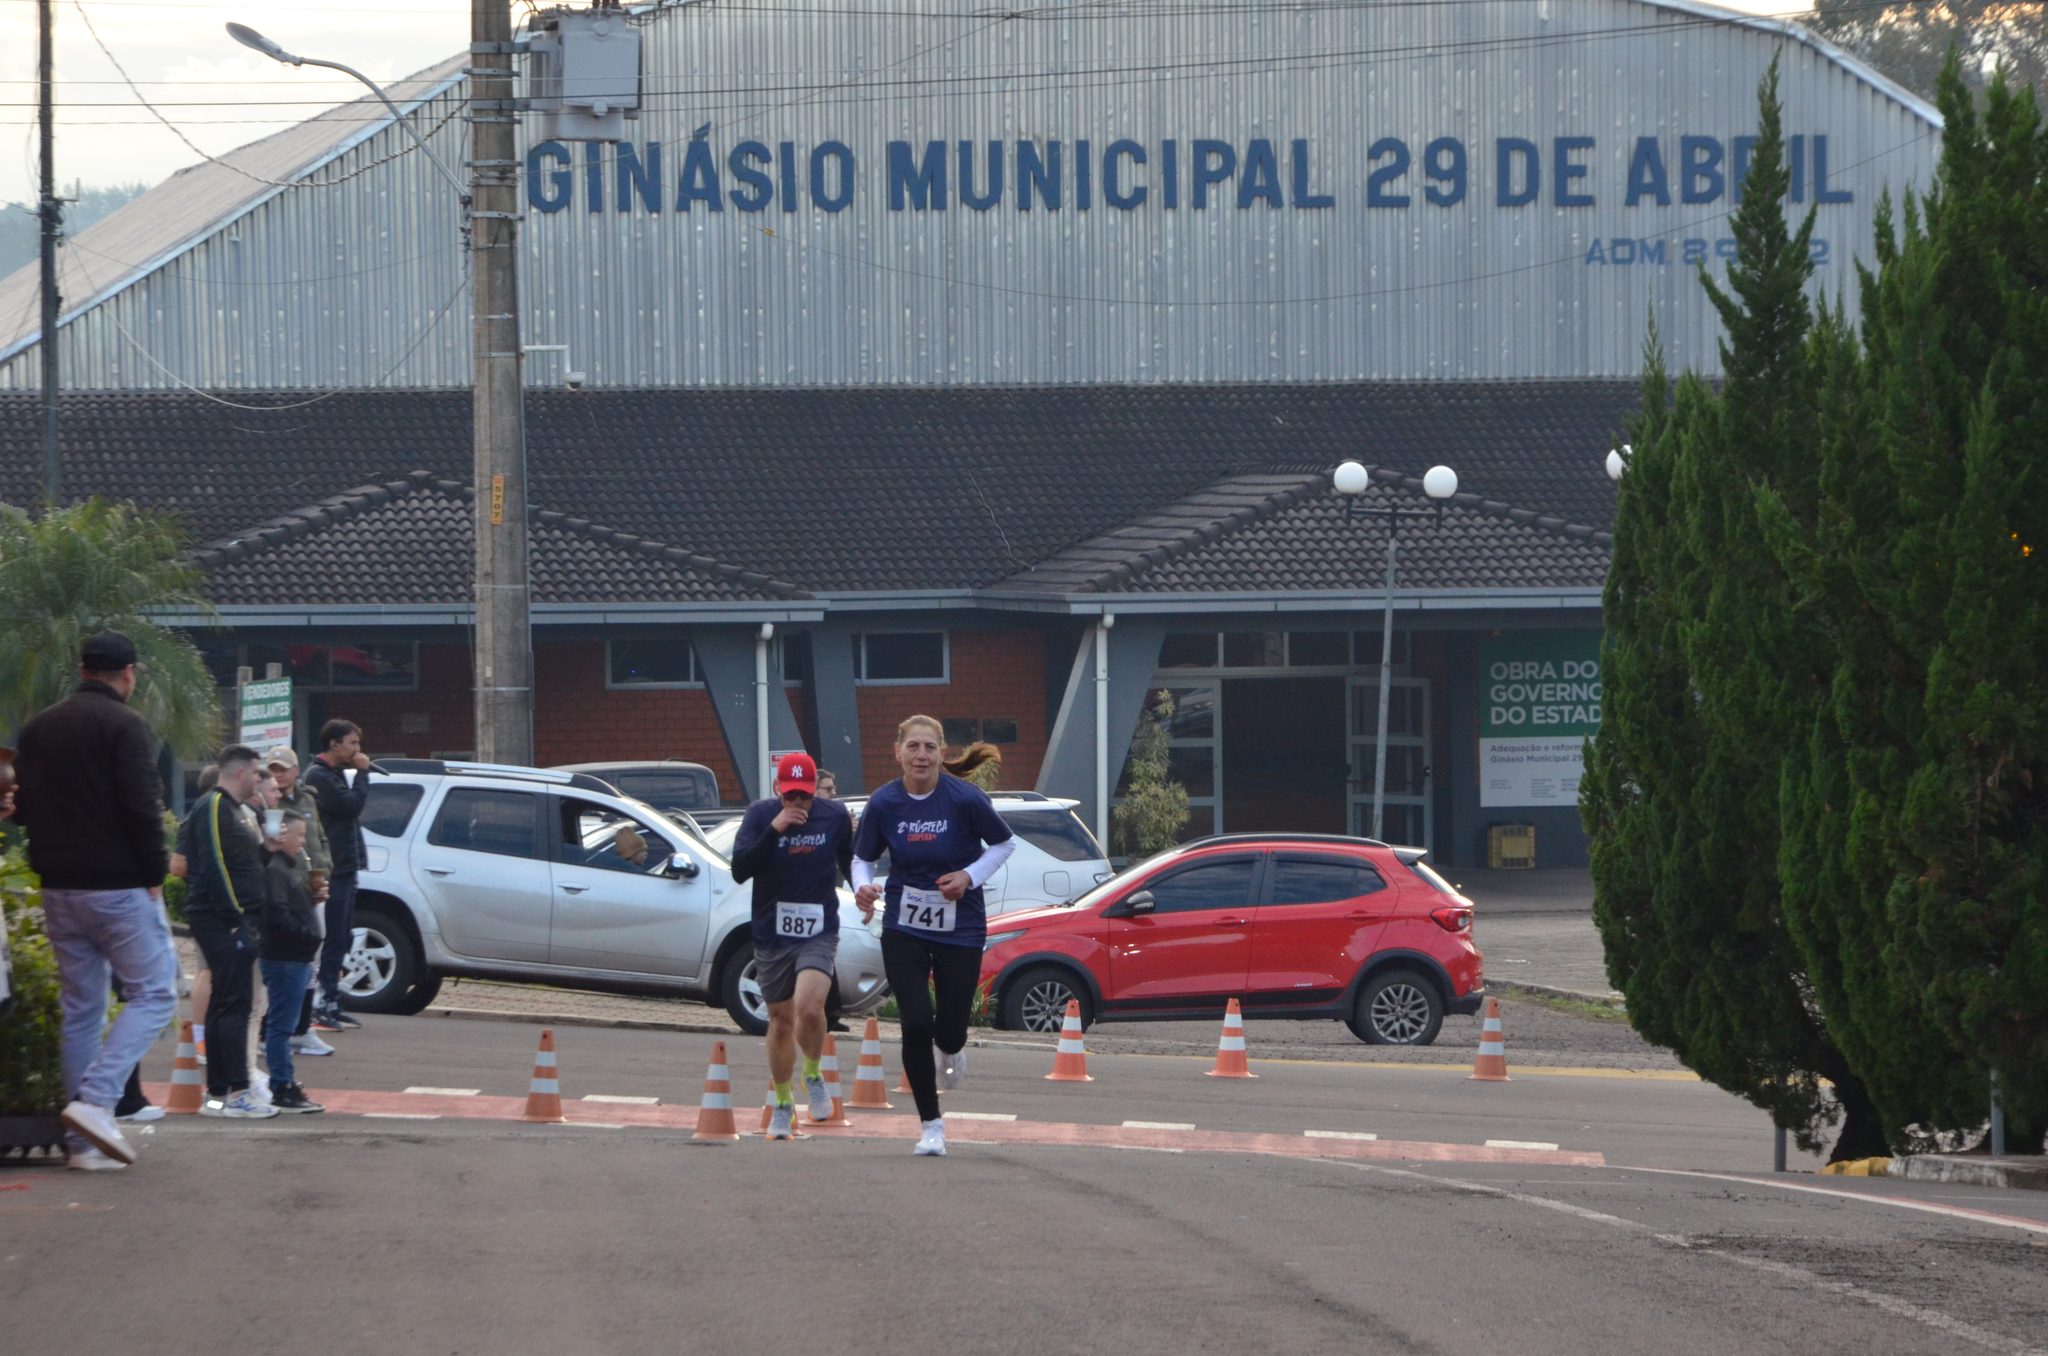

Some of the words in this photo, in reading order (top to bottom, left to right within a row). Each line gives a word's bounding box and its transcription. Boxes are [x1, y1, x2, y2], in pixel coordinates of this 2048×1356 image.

[526, 121, 855, 213] GINÁSIO
[887, 138, 1335, 212] MUNICIPAL
[1367, 137, 1468, 207] 29
[1496, 137, 1596, 207] DE
[1490, 661, 1557, 680] OBRA
[1563, 660, 1599, 679] DO
[1490, 706, 1526, 724] DO
[1532, 705, 1602, 724] ESTAD
[1490, 755, 1524, 763] Ginásio
[1526, 754, 1570, 762] Municipal
[791, 765, 803, 778] NY
[782, 916, 817, 935] 887
[906, 903, 944, 929] 741
